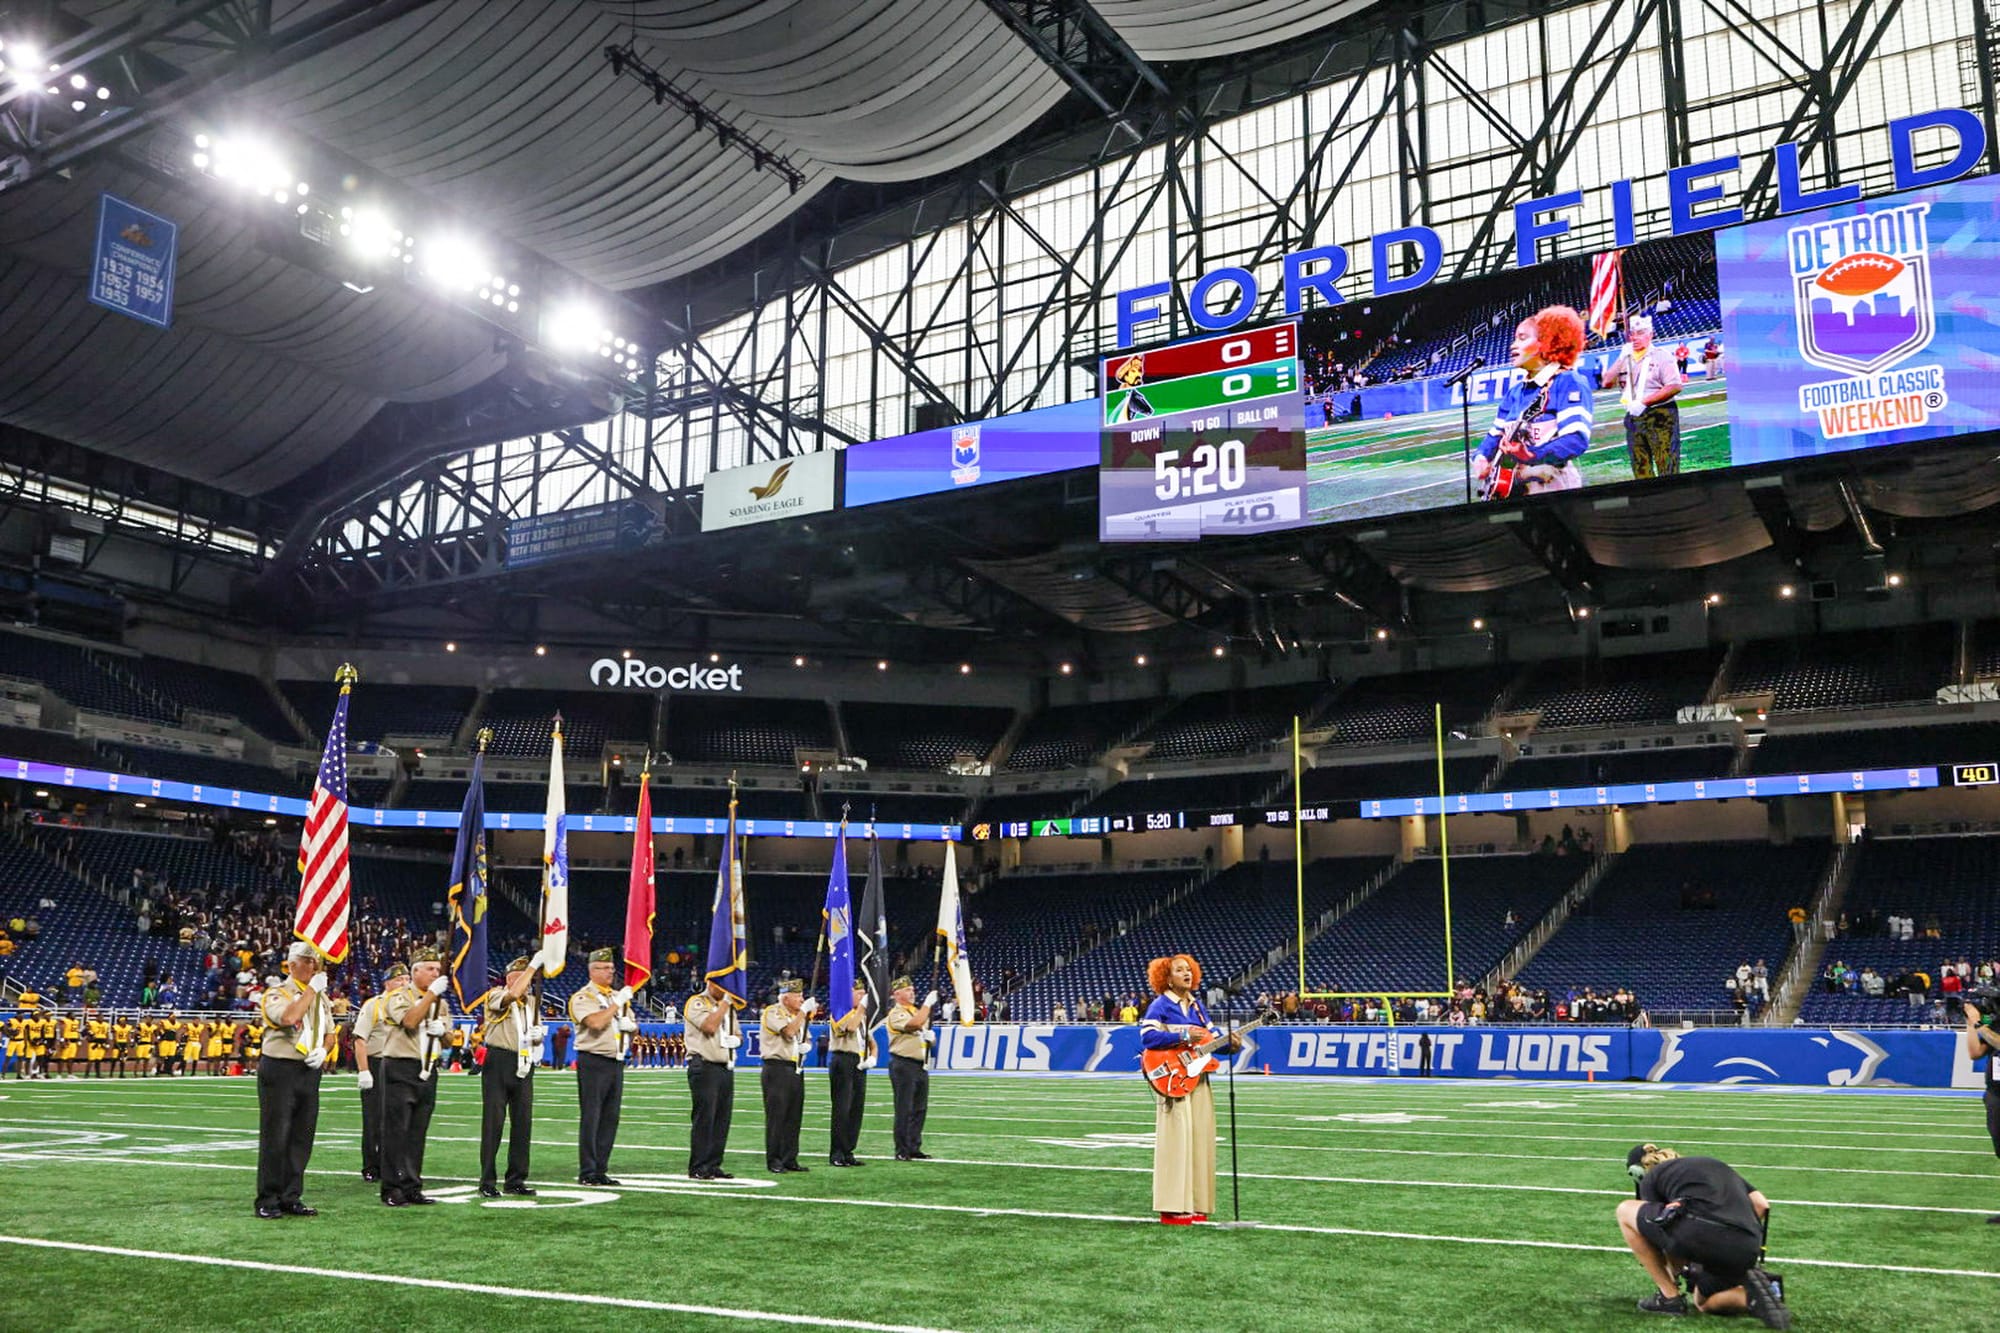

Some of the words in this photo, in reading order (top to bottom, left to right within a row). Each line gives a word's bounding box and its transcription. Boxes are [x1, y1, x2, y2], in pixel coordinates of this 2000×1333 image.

[1116, 225, 1445, 349] FORD
[1514, 107, 1986, 267] FIELD
[1791, 205, 1926, 274] DETROIT
[101, 271, 131, 292] 1952
[135, 284, 163, 304] 1957
[103, 257, 133, 278] 1935
[136, 271, 164, 291] 1954
[100, 285, 129, 306] 1953
[1221, 339, 1251, 363] 0
[1222, 373, 1252, 397] 0
[1803, 381, 1876, 408] FOOTBALL
[1879, 368, 1940, 397] CLASSIC
[1131, 427, 1160, 443] DOWN
[1191, 418, 1204, 432] TO
[1206, 416, 1221, 431] GO
[1237, 410, 1262, 425] BALL
[1264, 406, 1278, 420] ON
[1822, 395, 1924, 435] WEEKEND
[1155, 439, 1246, 501] 5:20
[729, 502, 771, 518] SOARING
[773, 496, 804, 510] EAGLE
[1222, 503, 1275, 525] 40
[1143, 520, 1161, 538] 1
[623, 659, 743, 691] Rocket
[1962, 767, 1990, 782] 40
[1147, 813, 1171, 829] 5:20
[1210, 813, 1234, 825] DOWN
[1265, 811, 1277, 823] TO
[1278, 810, 1290, 822] GO
[1316, 807, 1329, 820] ON
[928, 1025, 1054, 1071] IONS
[1387, 1032, 1399, 1072] LIONS
[1477, 1034, 1612, 1073] LIONS
